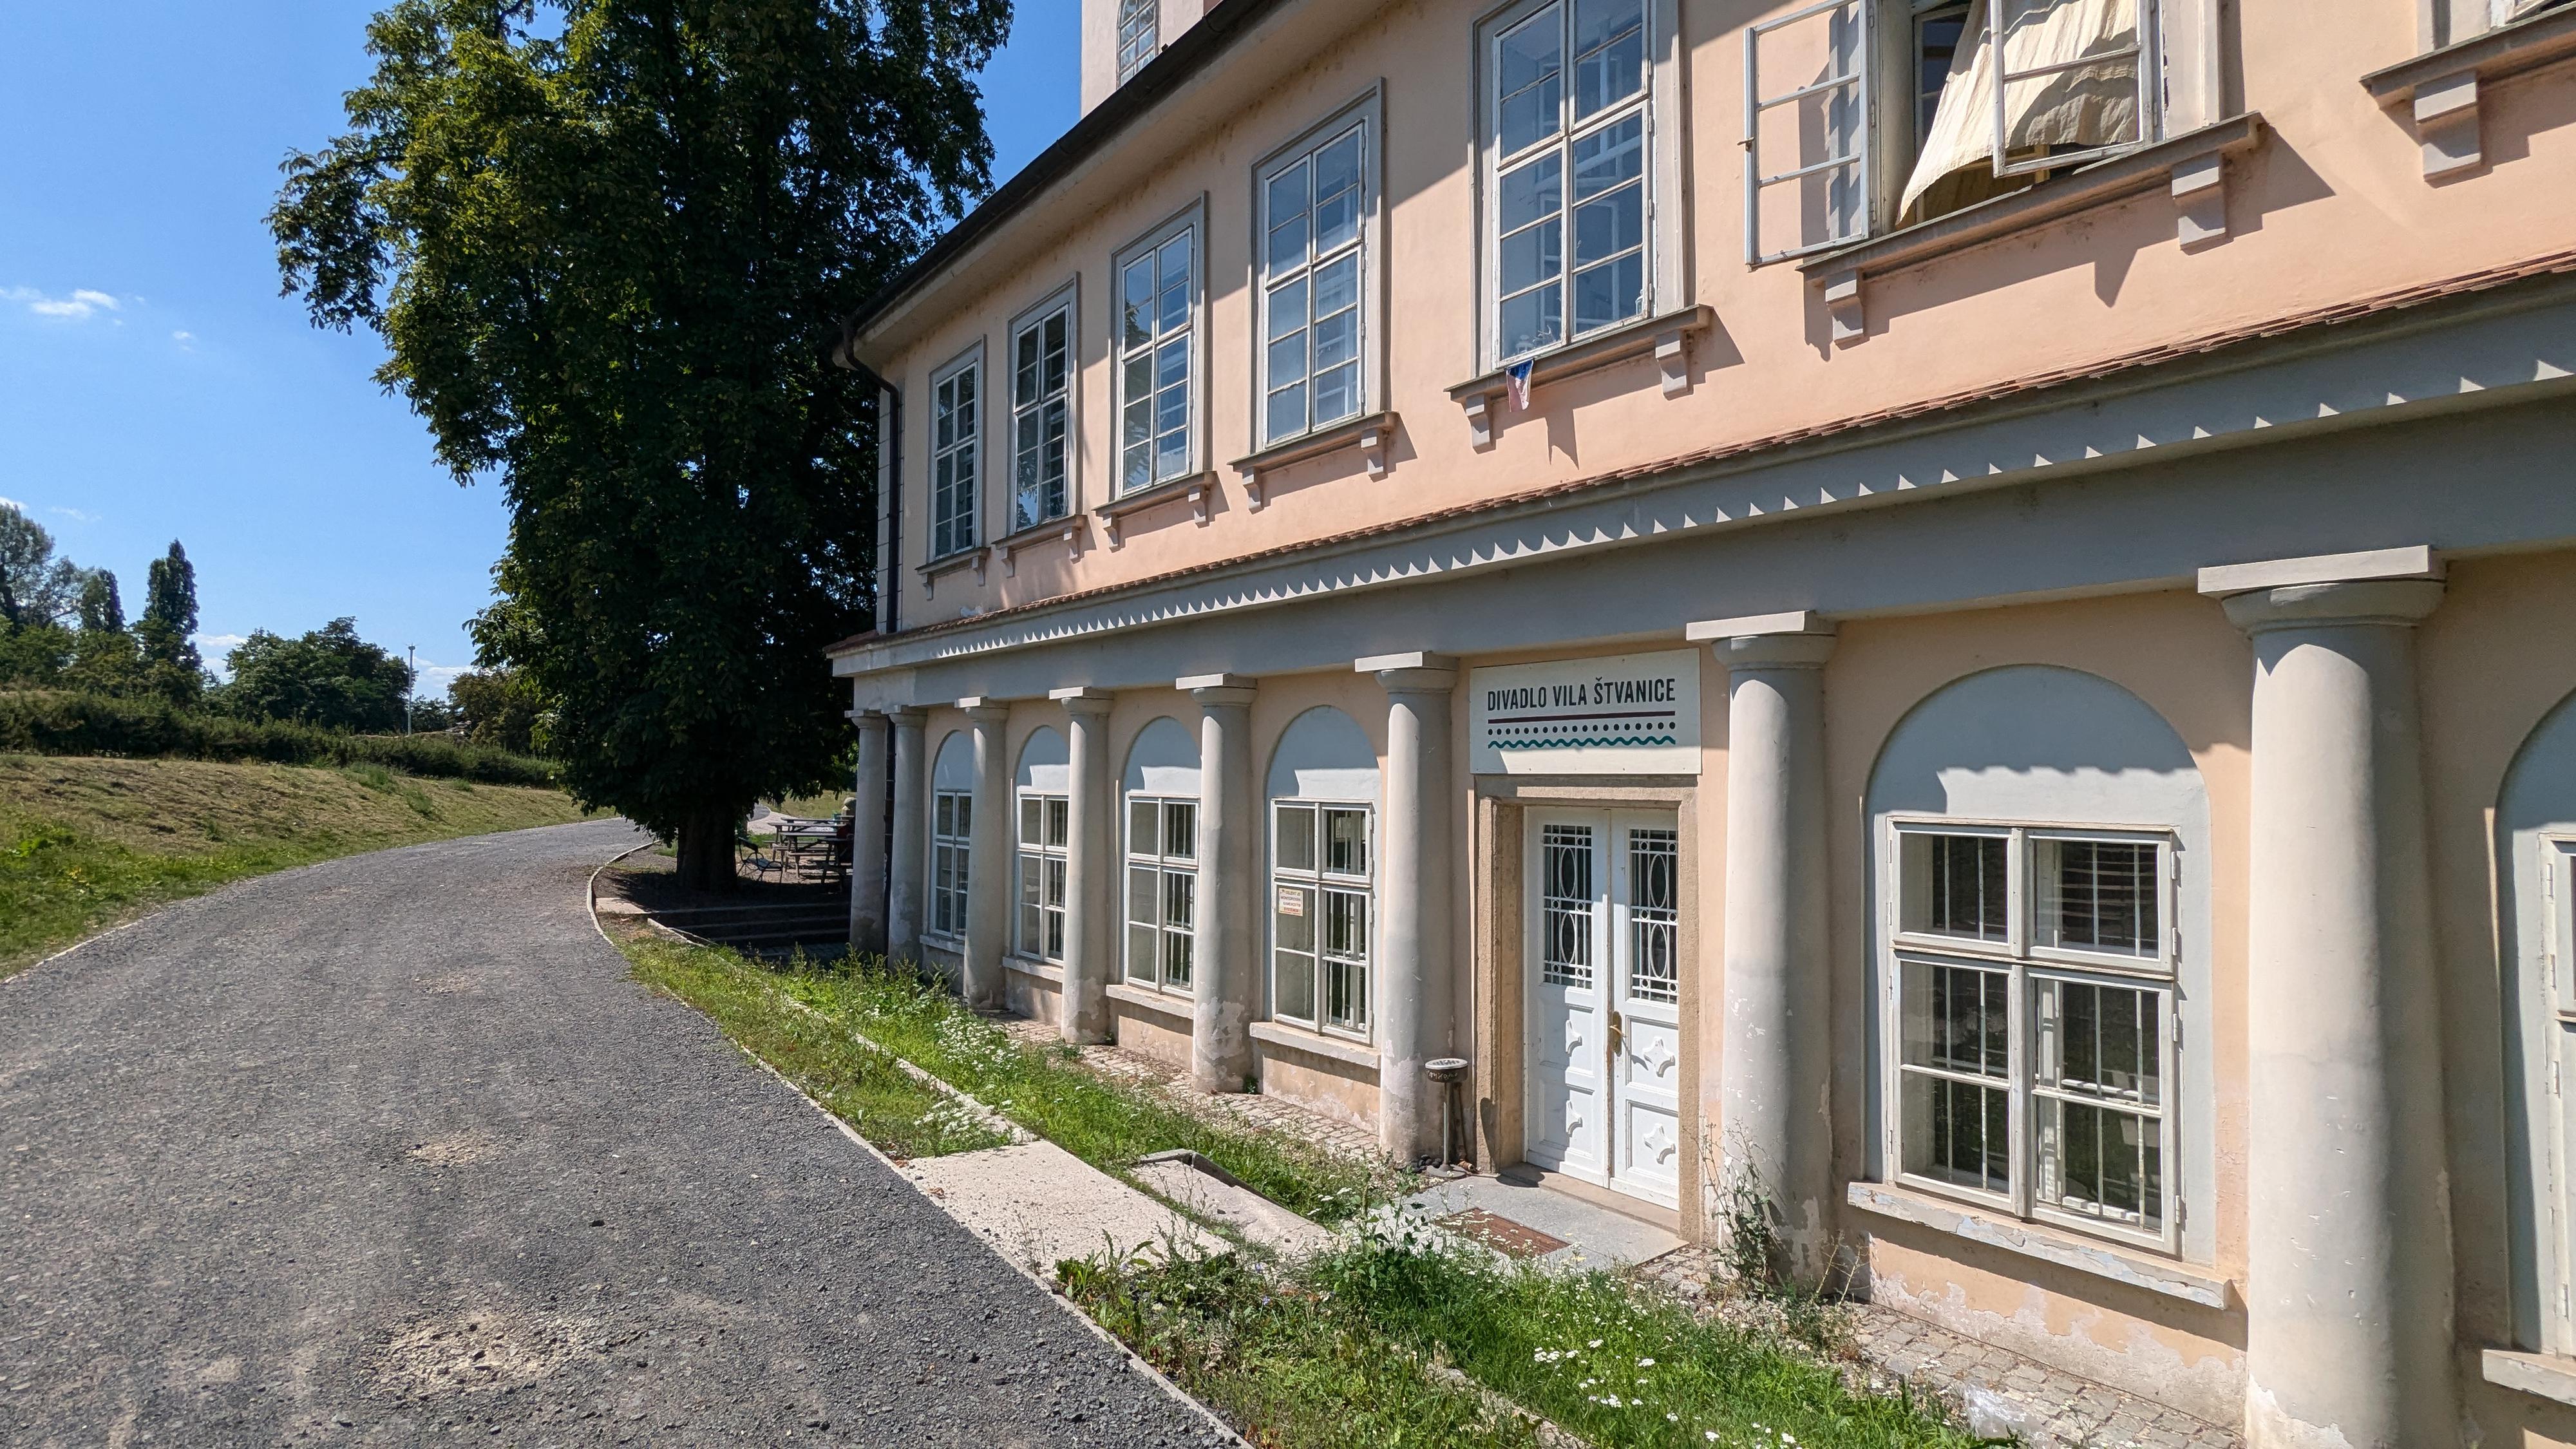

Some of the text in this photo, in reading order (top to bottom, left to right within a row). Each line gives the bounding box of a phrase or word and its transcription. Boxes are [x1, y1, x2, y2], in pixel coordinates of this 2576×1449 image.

[1488, 677, 1676, 711] DIVADLO VILA ŠTVANICE
